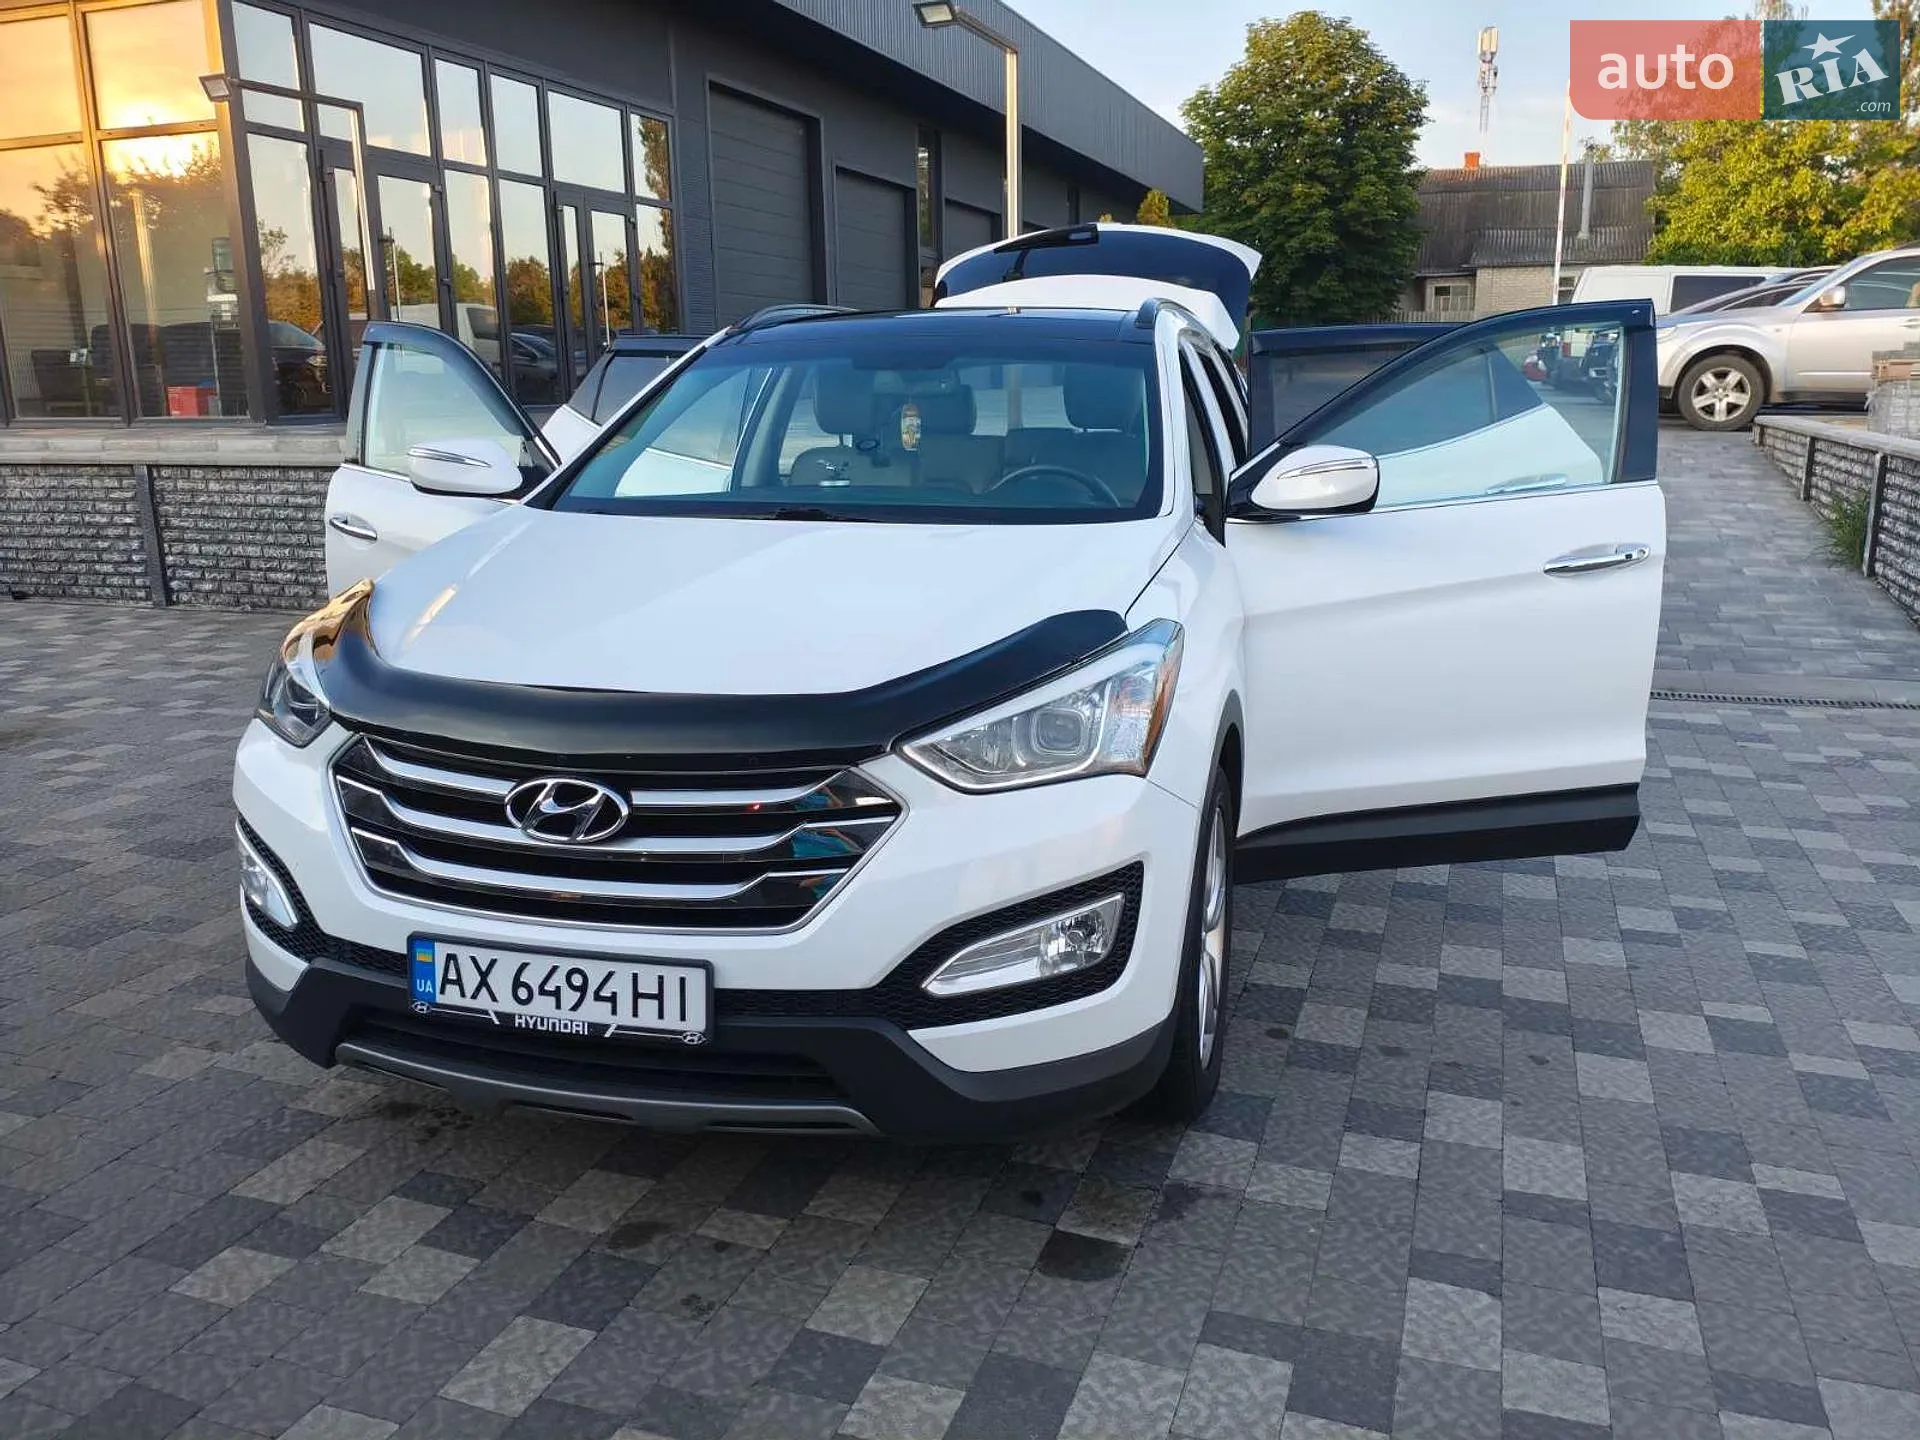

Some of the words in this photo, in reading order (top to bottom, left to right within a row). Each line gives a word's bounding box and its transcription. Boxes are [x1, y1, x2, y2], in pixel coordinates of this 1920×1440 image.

[416, 979, 434, 994] UA
[439, 953, 499, 1003] AX
[511, 962, 618, 1016] 6494
[514, 1014, 588, 1036] HYUNDAI
